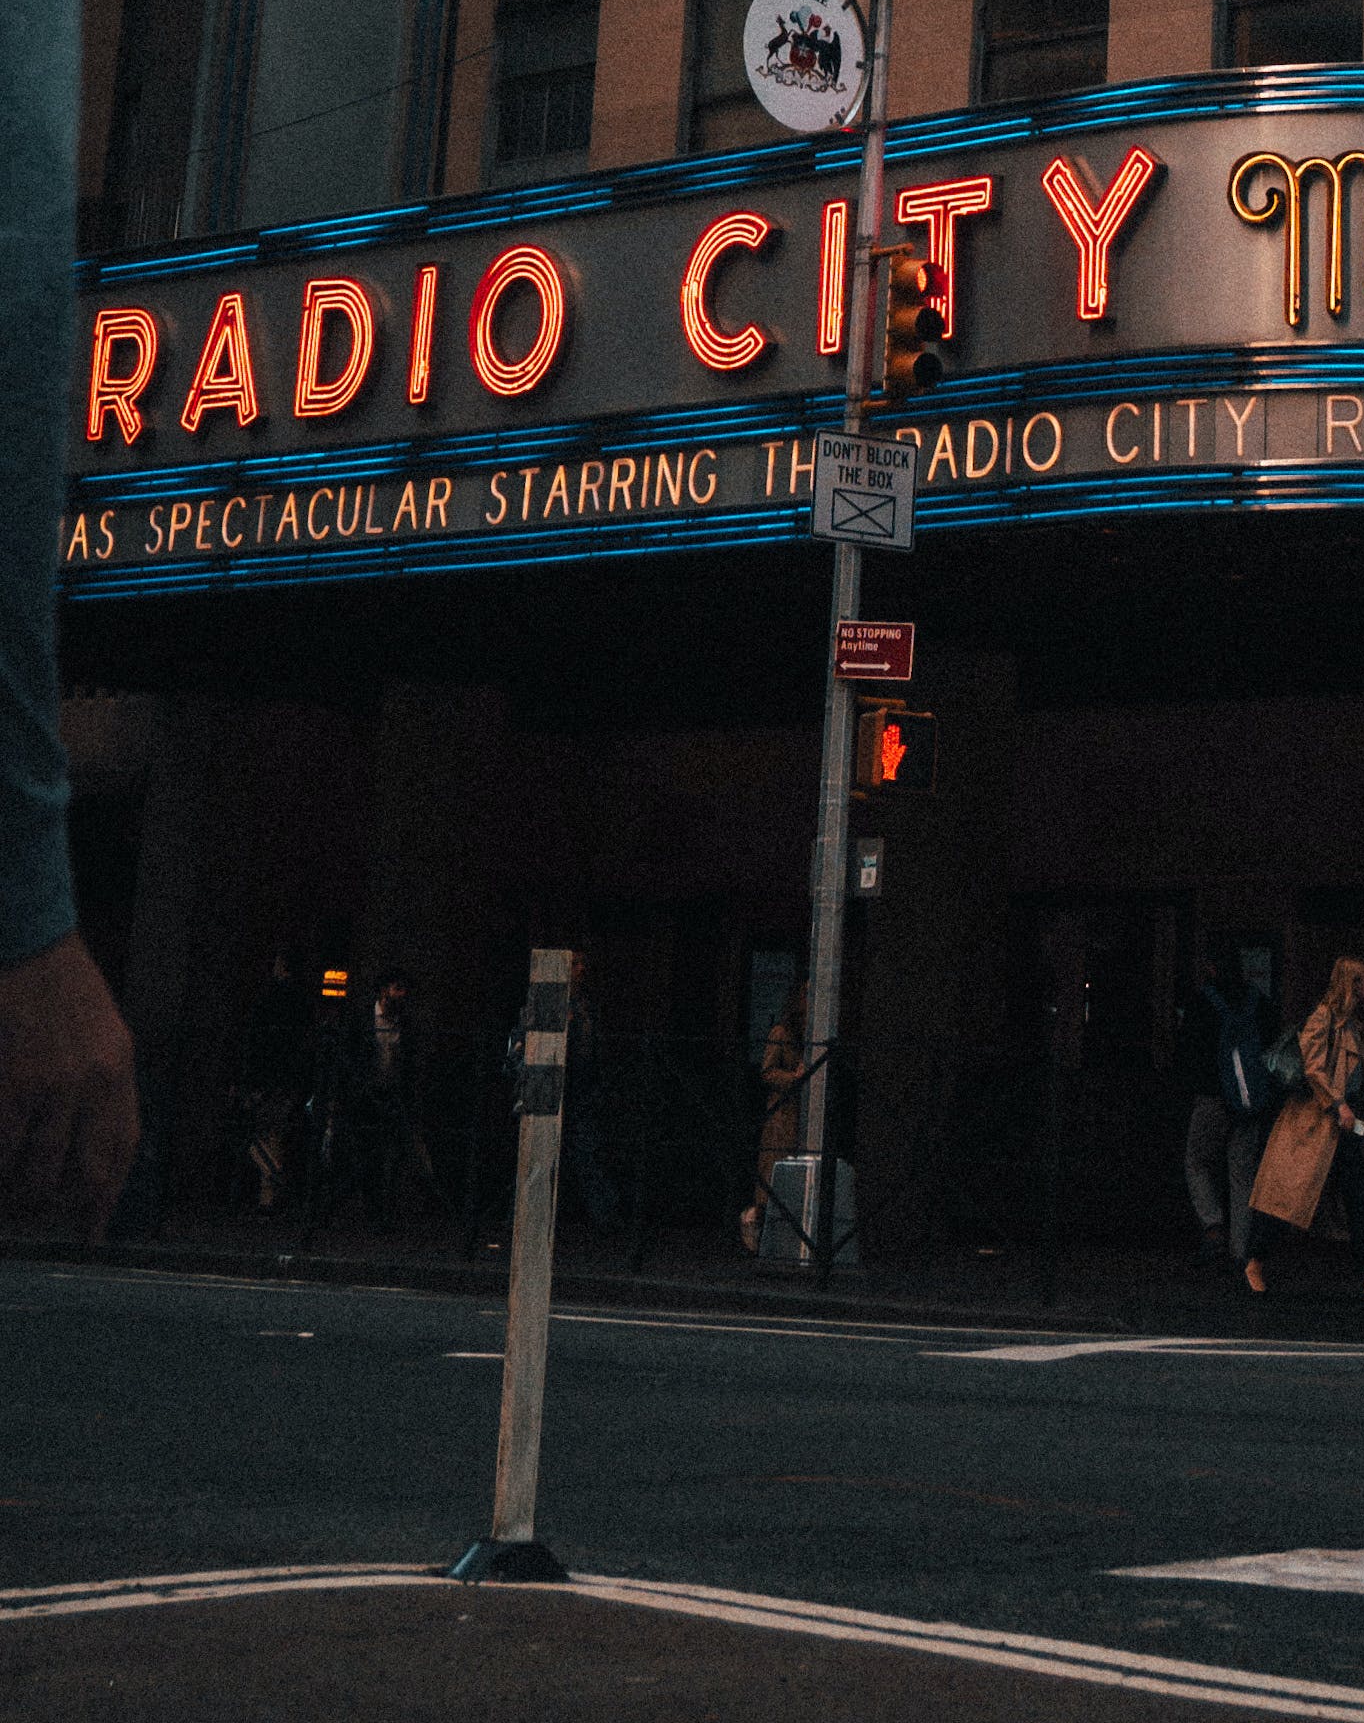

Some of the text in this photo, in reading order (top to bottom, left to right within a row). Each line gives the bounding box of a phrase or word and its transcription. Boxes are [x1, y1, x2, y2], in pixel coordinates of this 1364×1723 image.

[84, 243, 567, 445] RADIO
[680, 145, 1157, 371] CITY
[823, 439, 910, 470] DON'T BLOCK
[58, 510, 116, 561] AS
[144, 477, 452, 554] SPECTACULAR
[485, 447, 719, 526] STARRING
[761, 438, 816, 496] TH
[1106, 396, 1258, 463] CITY
[838, 465, 895, 491] THE BOX
[841, 628, 902, 640] NO STOPPING
[841, 640, 879, 653] Anytime
